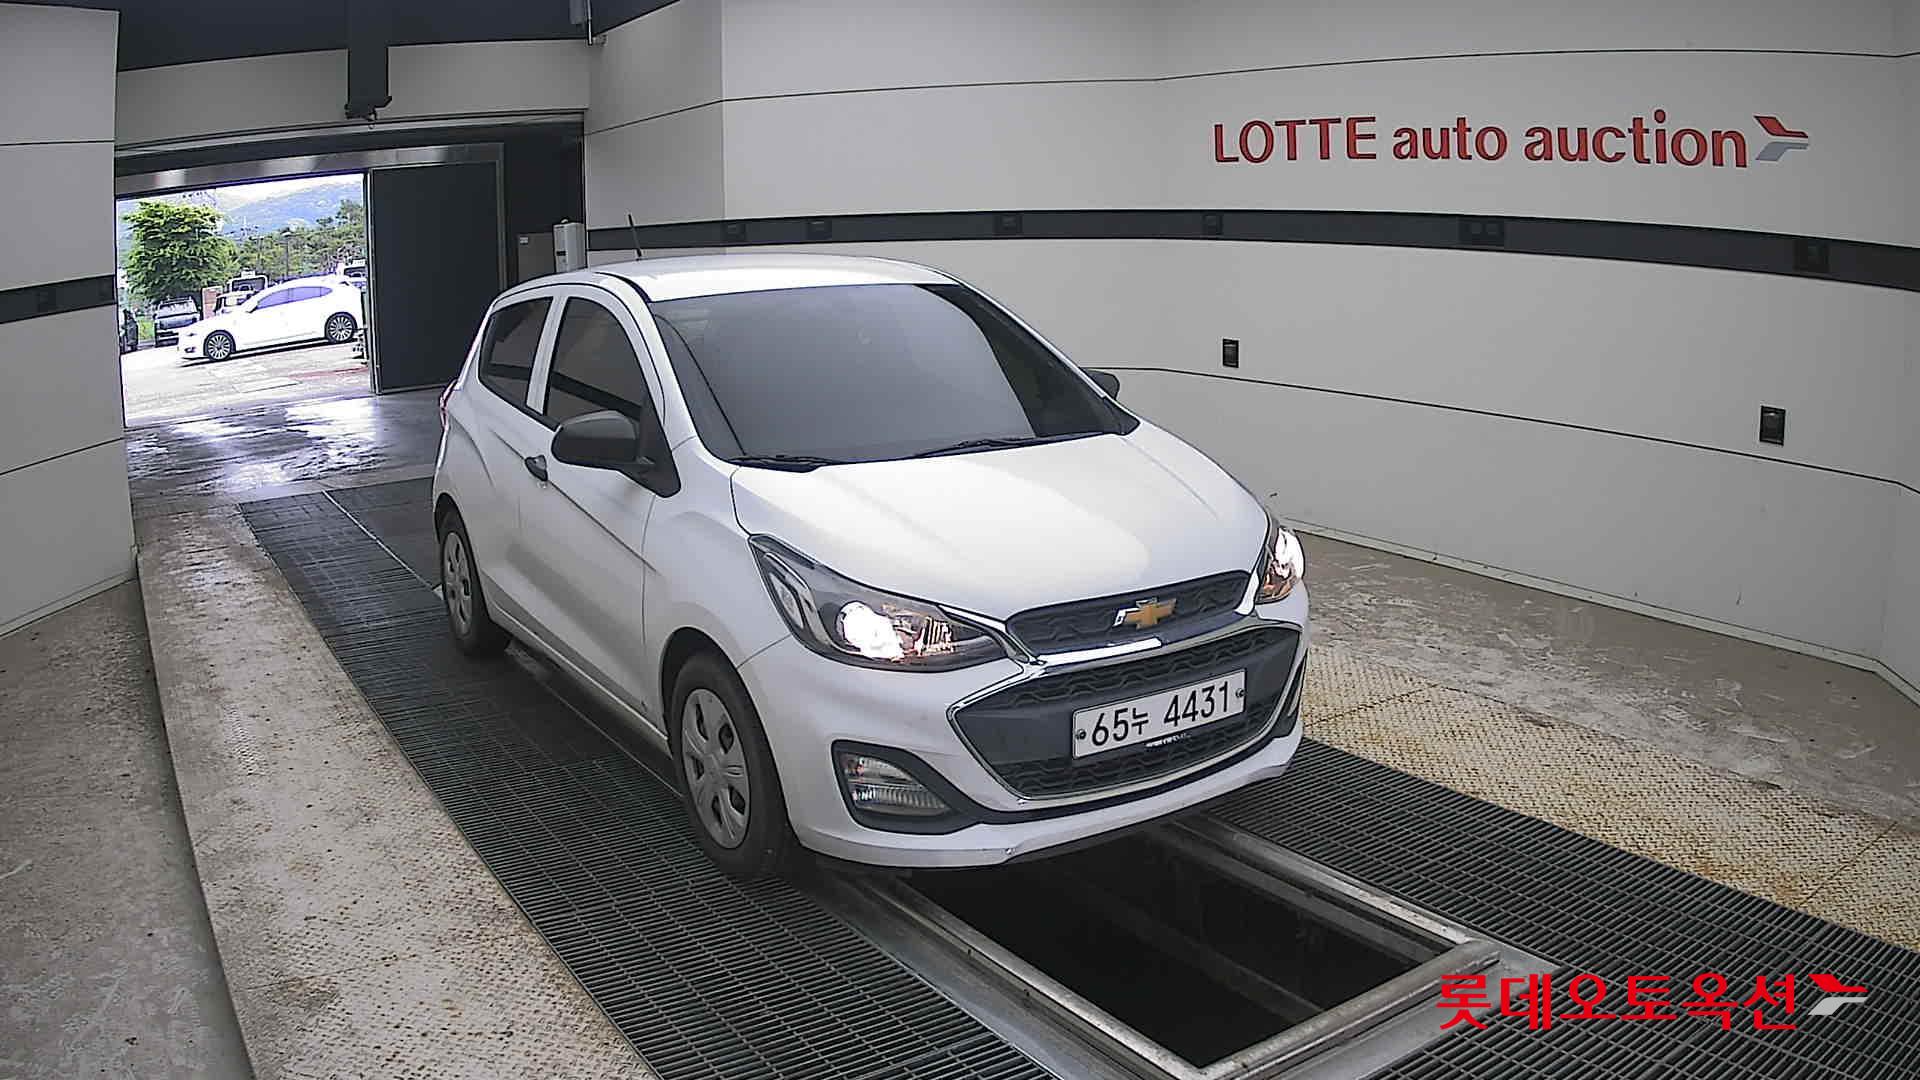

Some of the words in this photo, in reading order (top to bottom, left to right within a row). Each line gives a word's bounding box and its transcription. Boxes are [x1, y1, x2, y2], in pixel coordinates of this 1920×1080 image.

[1214, 116, 1377, 164] LOTTE
[1392, 117, 1508, 161] auto
[1523, 109, 1748, 168] auction
[1091, 707, 1149, 746] 65누
[1163, 680, 1229, 727] 4431
